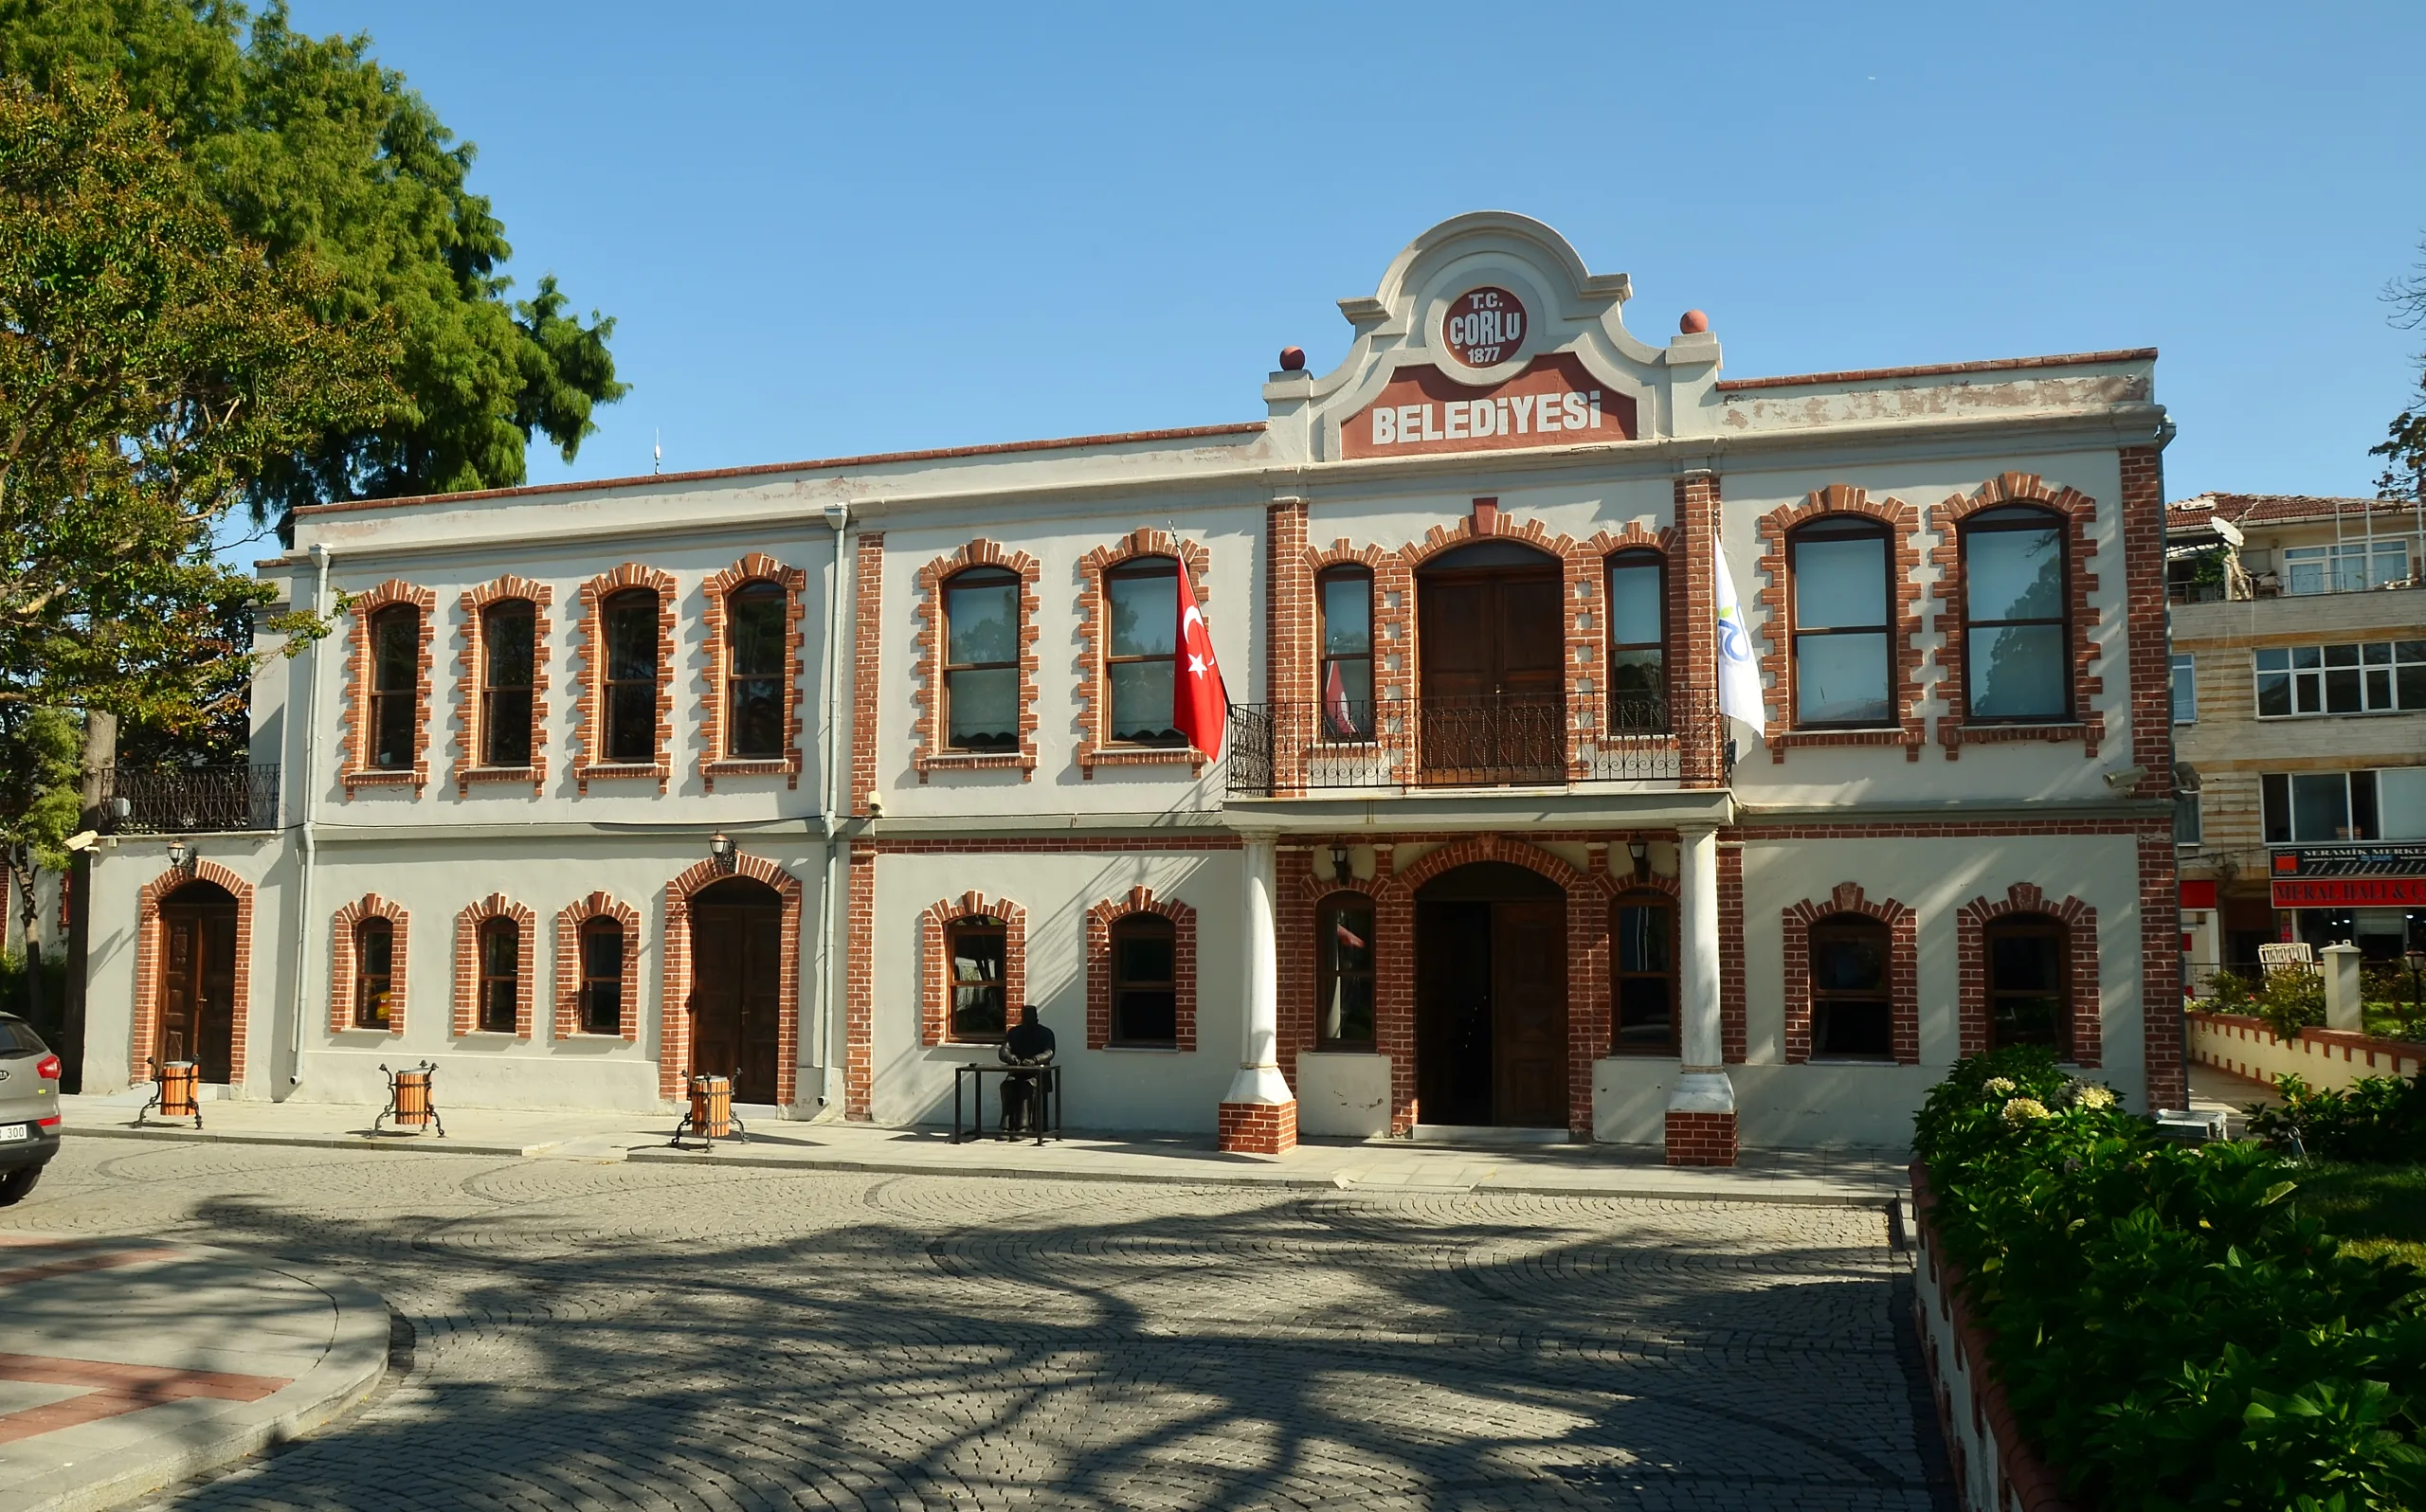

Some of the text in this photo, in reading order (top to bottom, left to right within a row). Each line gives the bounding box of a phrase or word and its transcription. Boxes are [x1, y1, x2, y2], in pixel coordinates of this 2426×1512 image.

[1469, 293, 1503, 309] T.C.
[1450, 311, 1520, 350] ÇORLU
[1468, 347, 1500, 364] 1877
[1372, 390, 1601, 445] BELEDİYESİ
[2276, 884, 2336, 900] MERAL
[2343, 883, 2387, 899] HALI
[2393, 883, 2406, 899] &
[8, 1126, 24, 1139] 300
